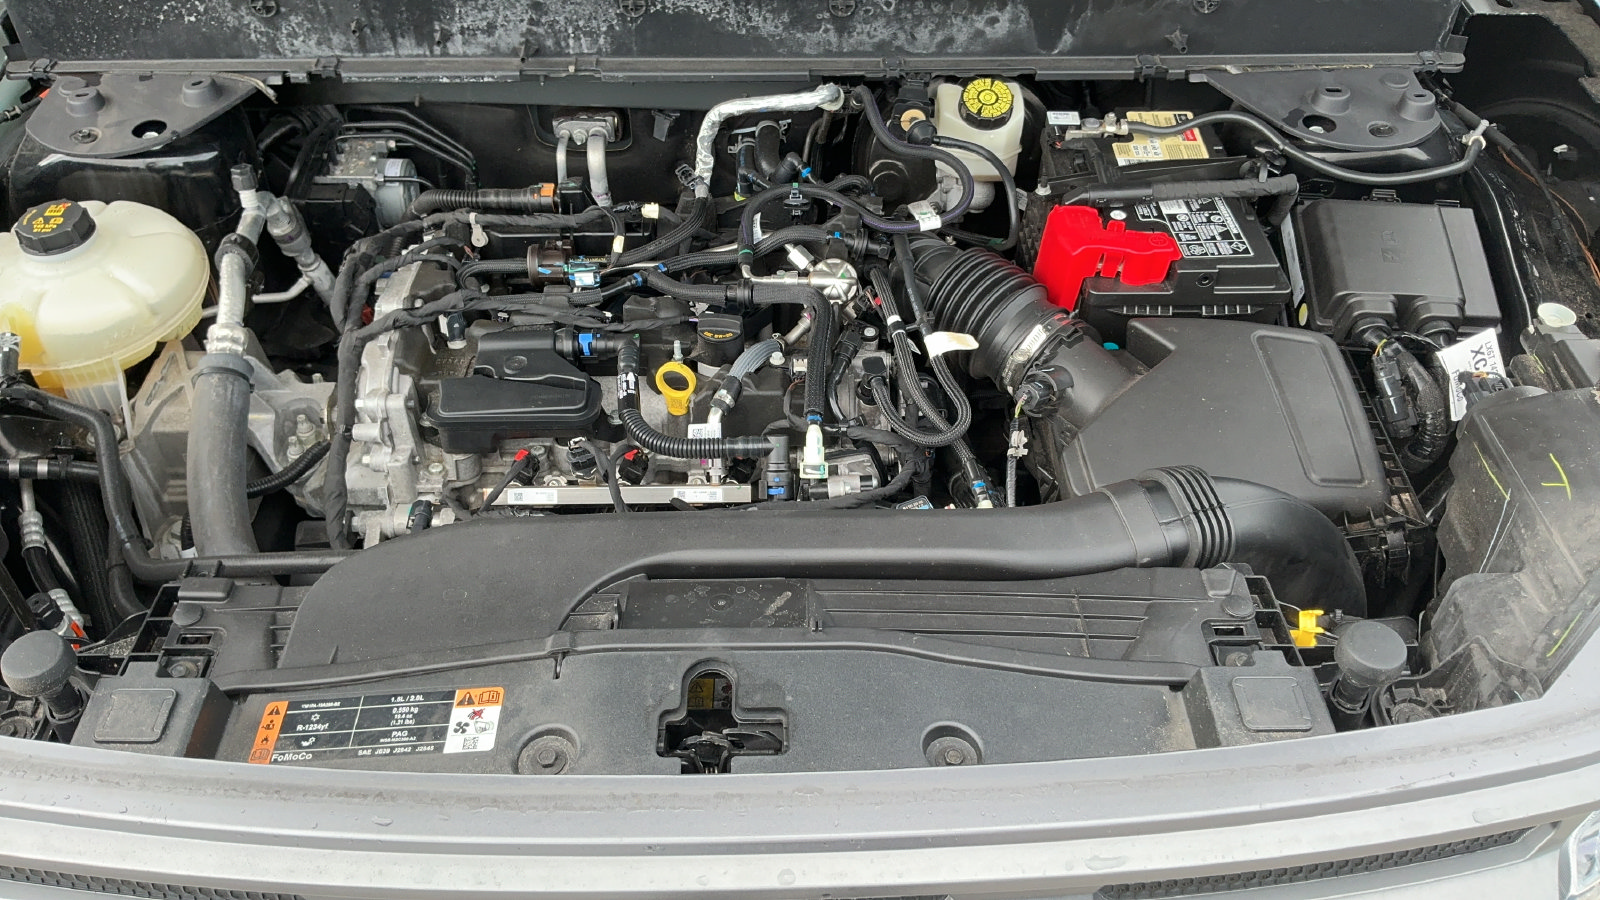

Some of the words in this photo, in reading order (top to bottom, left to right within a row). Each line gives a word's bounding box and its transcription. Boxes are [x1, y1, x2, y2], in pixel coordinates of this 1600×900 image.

[1471, 345, 1487, 370] XC
[410, 706, 419, 714] kg
[297, 723, 329, 731] R-1234yf
[391, 730, 408, 738] PAG
[271, 752, 312, 761] FoMoCo
